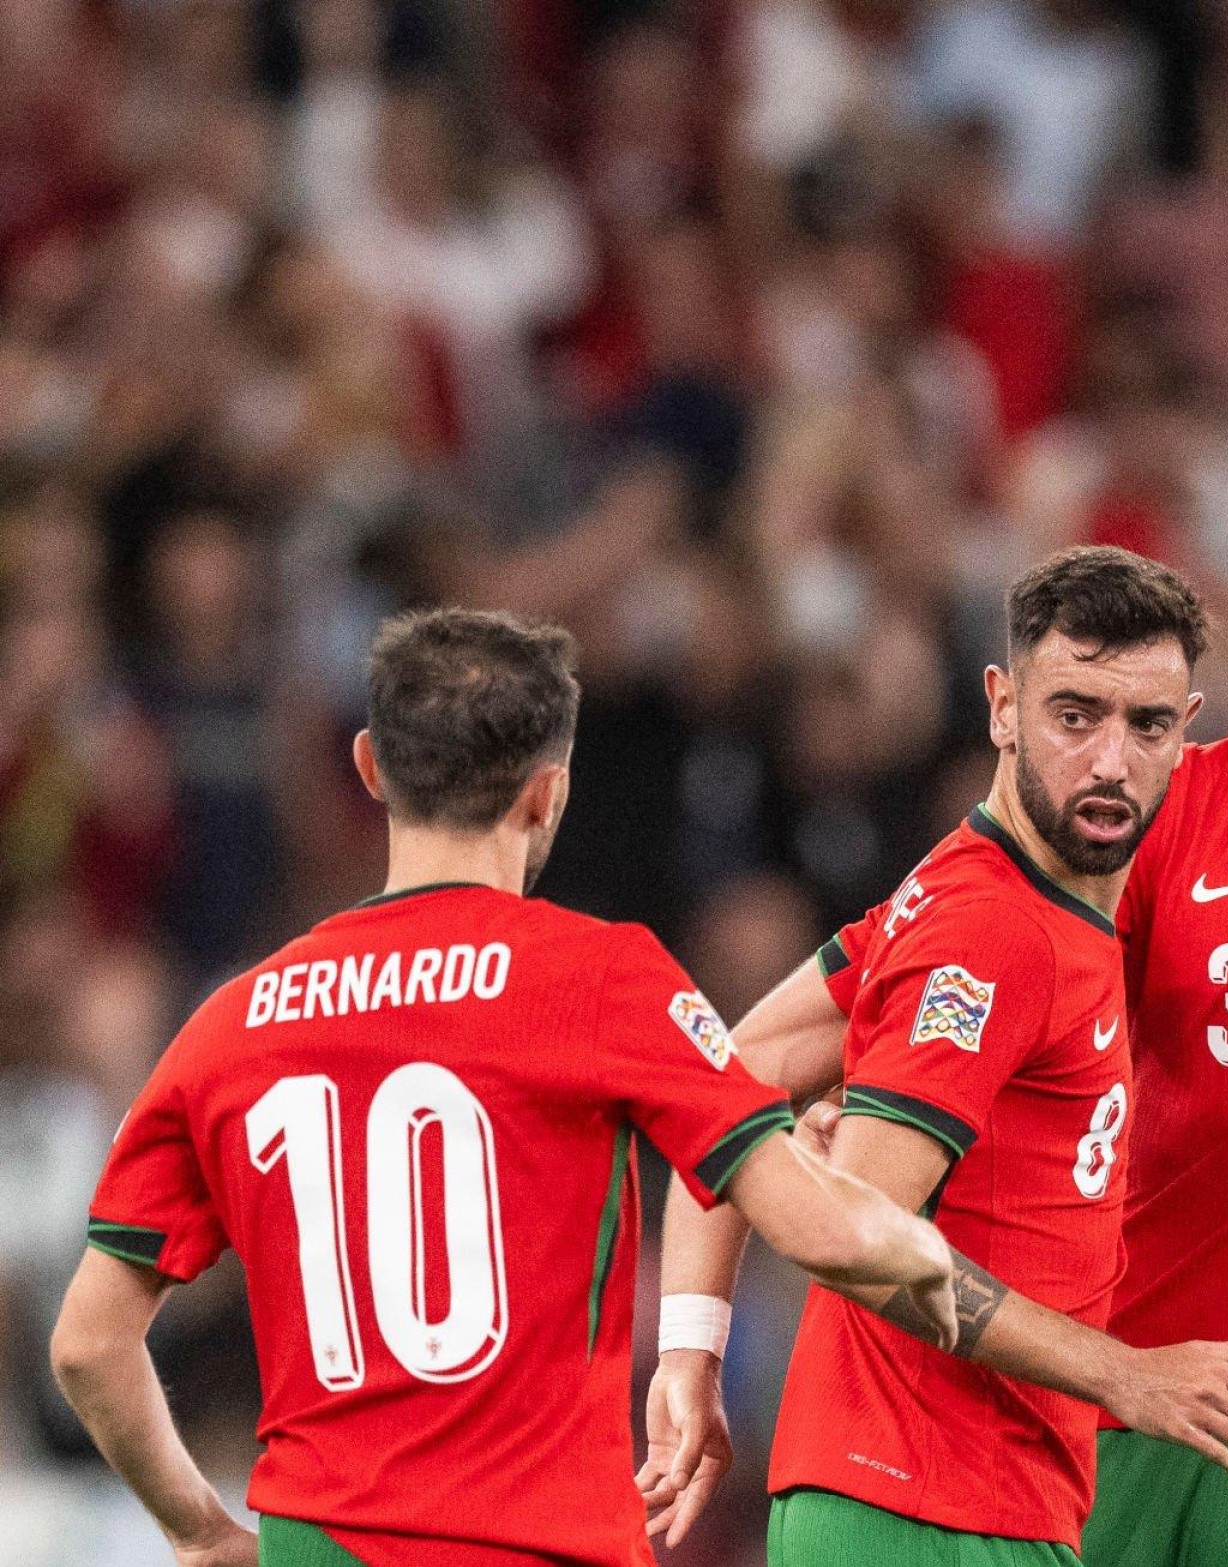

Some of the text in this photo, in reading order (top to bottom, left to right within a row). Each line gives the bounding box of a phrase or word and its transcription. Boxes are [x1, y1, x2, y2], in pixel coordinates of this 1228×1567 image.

[245, 942, 511, 1028] BERNARDO
[1073, 1083, 1127, 1199] 8
[245, 1062, 509, 1392] 10
